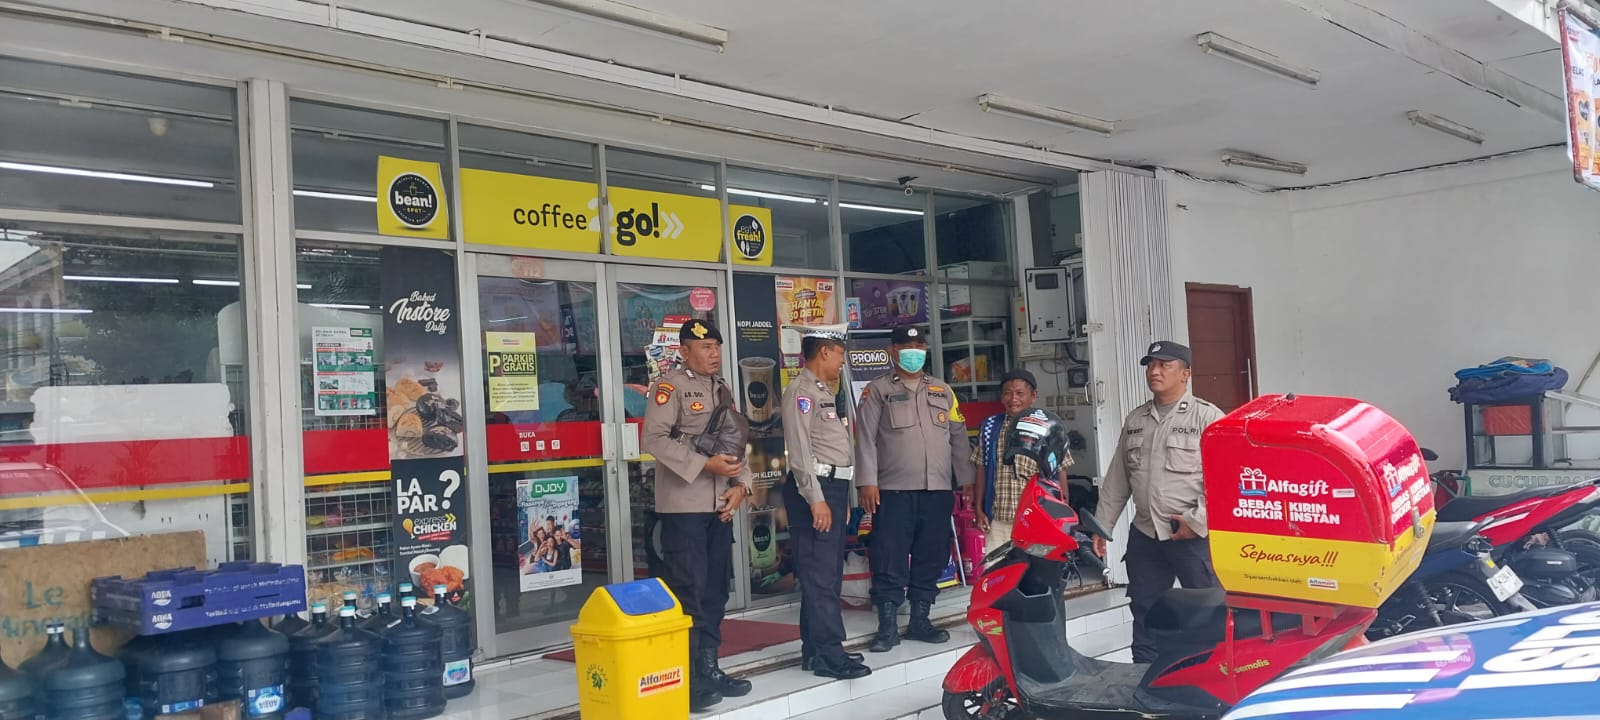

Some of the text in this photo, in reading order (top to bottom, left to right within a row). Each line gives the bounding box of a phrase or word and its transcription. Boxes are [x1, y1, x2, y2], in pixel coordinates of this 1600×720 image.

[395, 191, 432, 208] bean!
[737, 230, 761, 242] fresh!
[410, 290, 436, 302] Baked
[389, 298, 451, 324] Instore
[425, 320, 447, 335] Daily
[489, 354, 501, 373] P
[502, 354, 535, 363] PARKIR
[851, 353, 886, 363] PROMO
[503, 362, 535, 372] GRATIS
[1172, 427, 1199, 435] POLRI
[397, 478, 422, 496] LA
[535, 482, 564, 493] DJOY
[1267, 480, 1329, 497] Alfagift
[1238, 498, 1282, 510] BEBAS
[1289, 502, 1327, 514] KIRIM
[1233, 508, 1283, 520] ONGKIR
[1290, 512, 1340, 525] INSTAN
[414, 516, 446, 526] express
[414, 522, 456, 535] CHICKEN
[1239, 544, 1339, 567] Sepuasnya!!!
[151, 590, 172, 599] AQUA
[152, 613, 173, 623] AQUA
[640, 668, 680, 687] Alfamart
